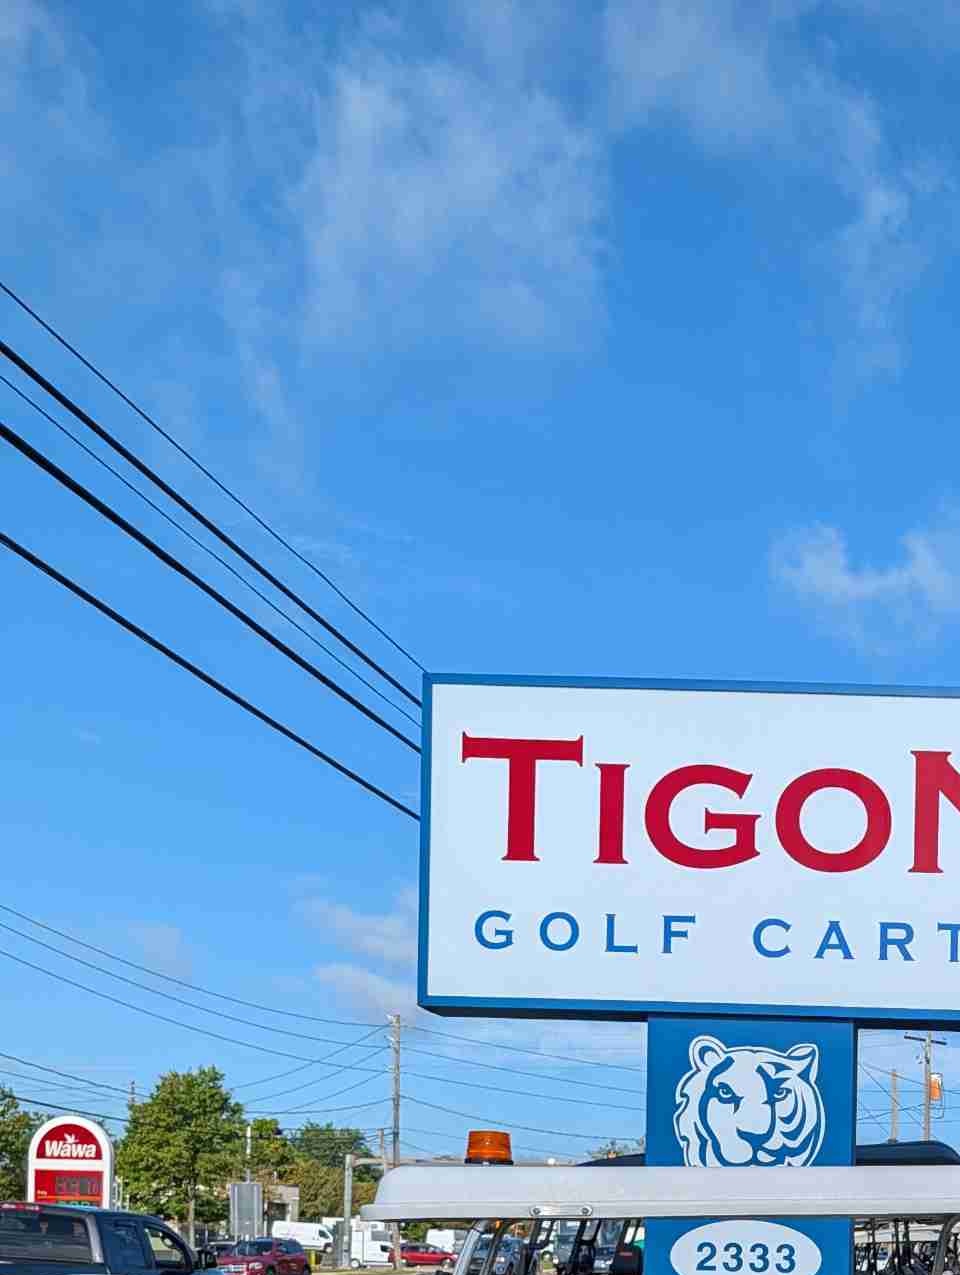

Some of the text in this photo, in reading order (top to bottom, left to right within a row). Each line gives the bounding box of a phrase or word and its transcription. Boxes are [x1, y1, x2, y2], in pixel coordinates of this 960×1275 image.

[474, 909, 697, 954] GOLF
[44, 1140, 97, 1158] Wawa
[695, 1241, 796, 1273] 2333
